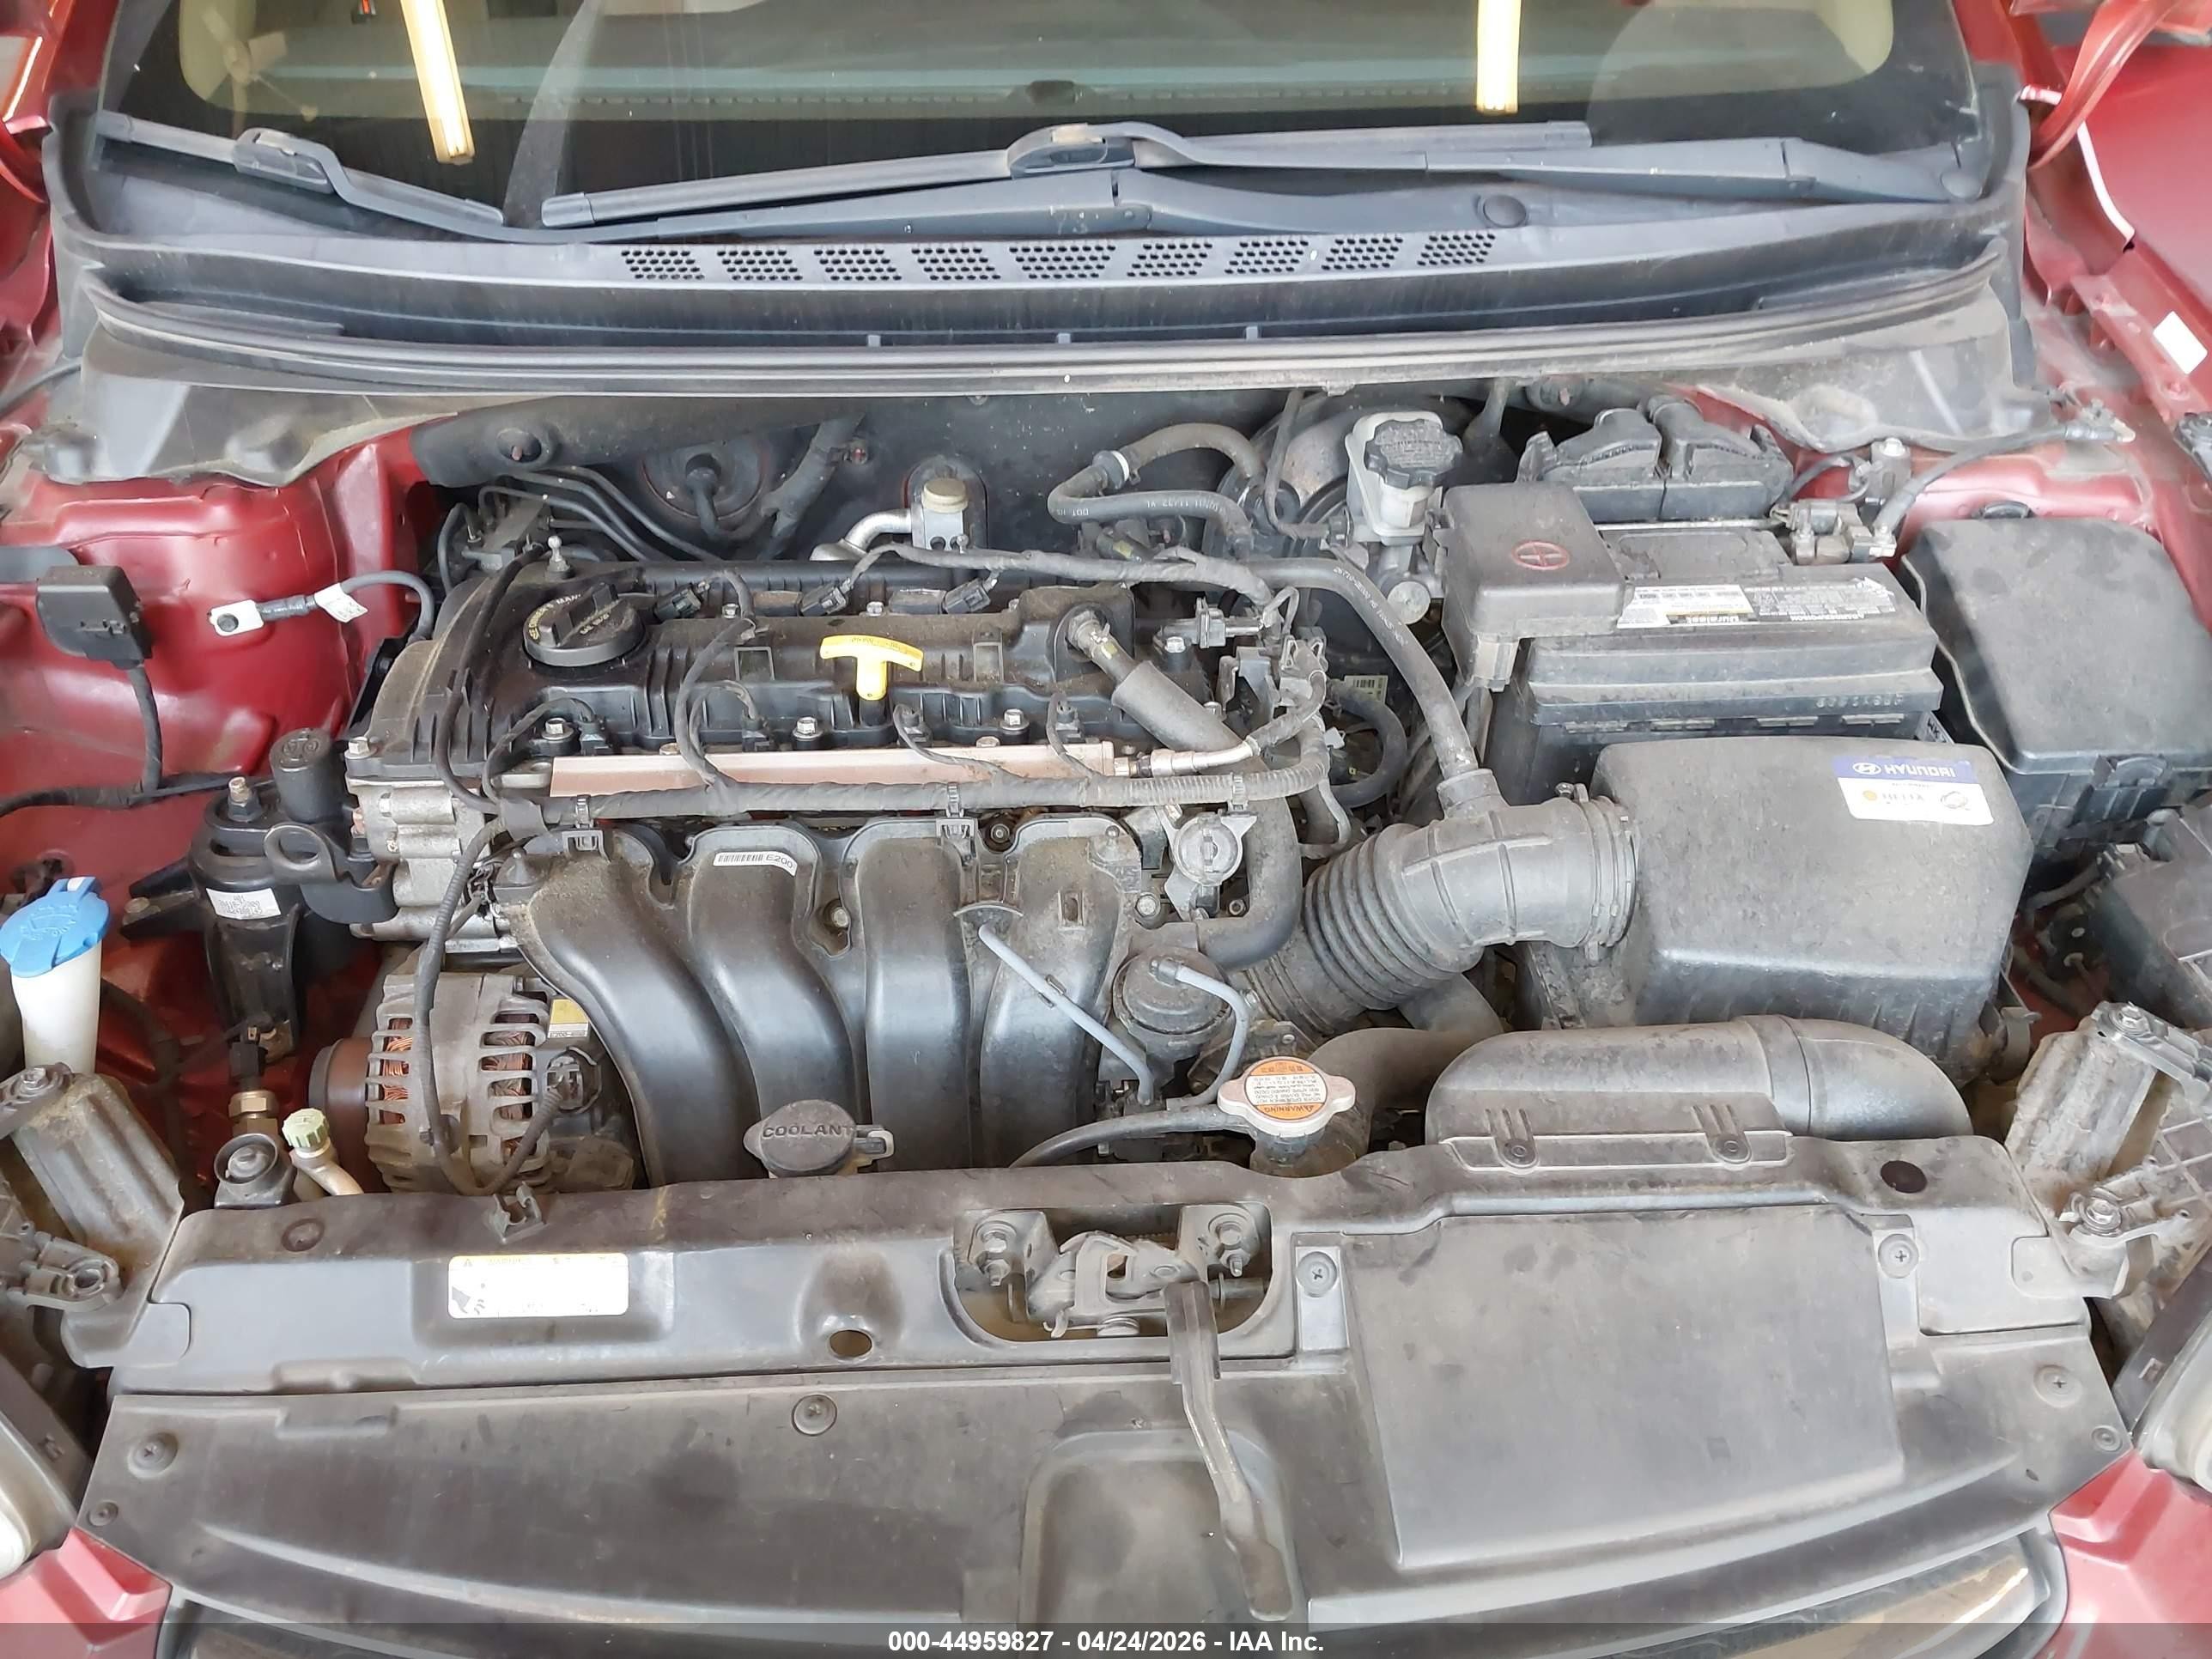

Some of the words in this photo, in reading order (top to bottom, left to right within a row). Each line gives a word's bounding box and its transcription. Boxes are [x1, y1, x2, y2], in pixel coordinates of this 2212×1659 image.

[1885, 764, 1956, 778] HYUNDAI
[765, 854, 793, 869] E200
[763, 1124, 852, 1138] COOLANT
